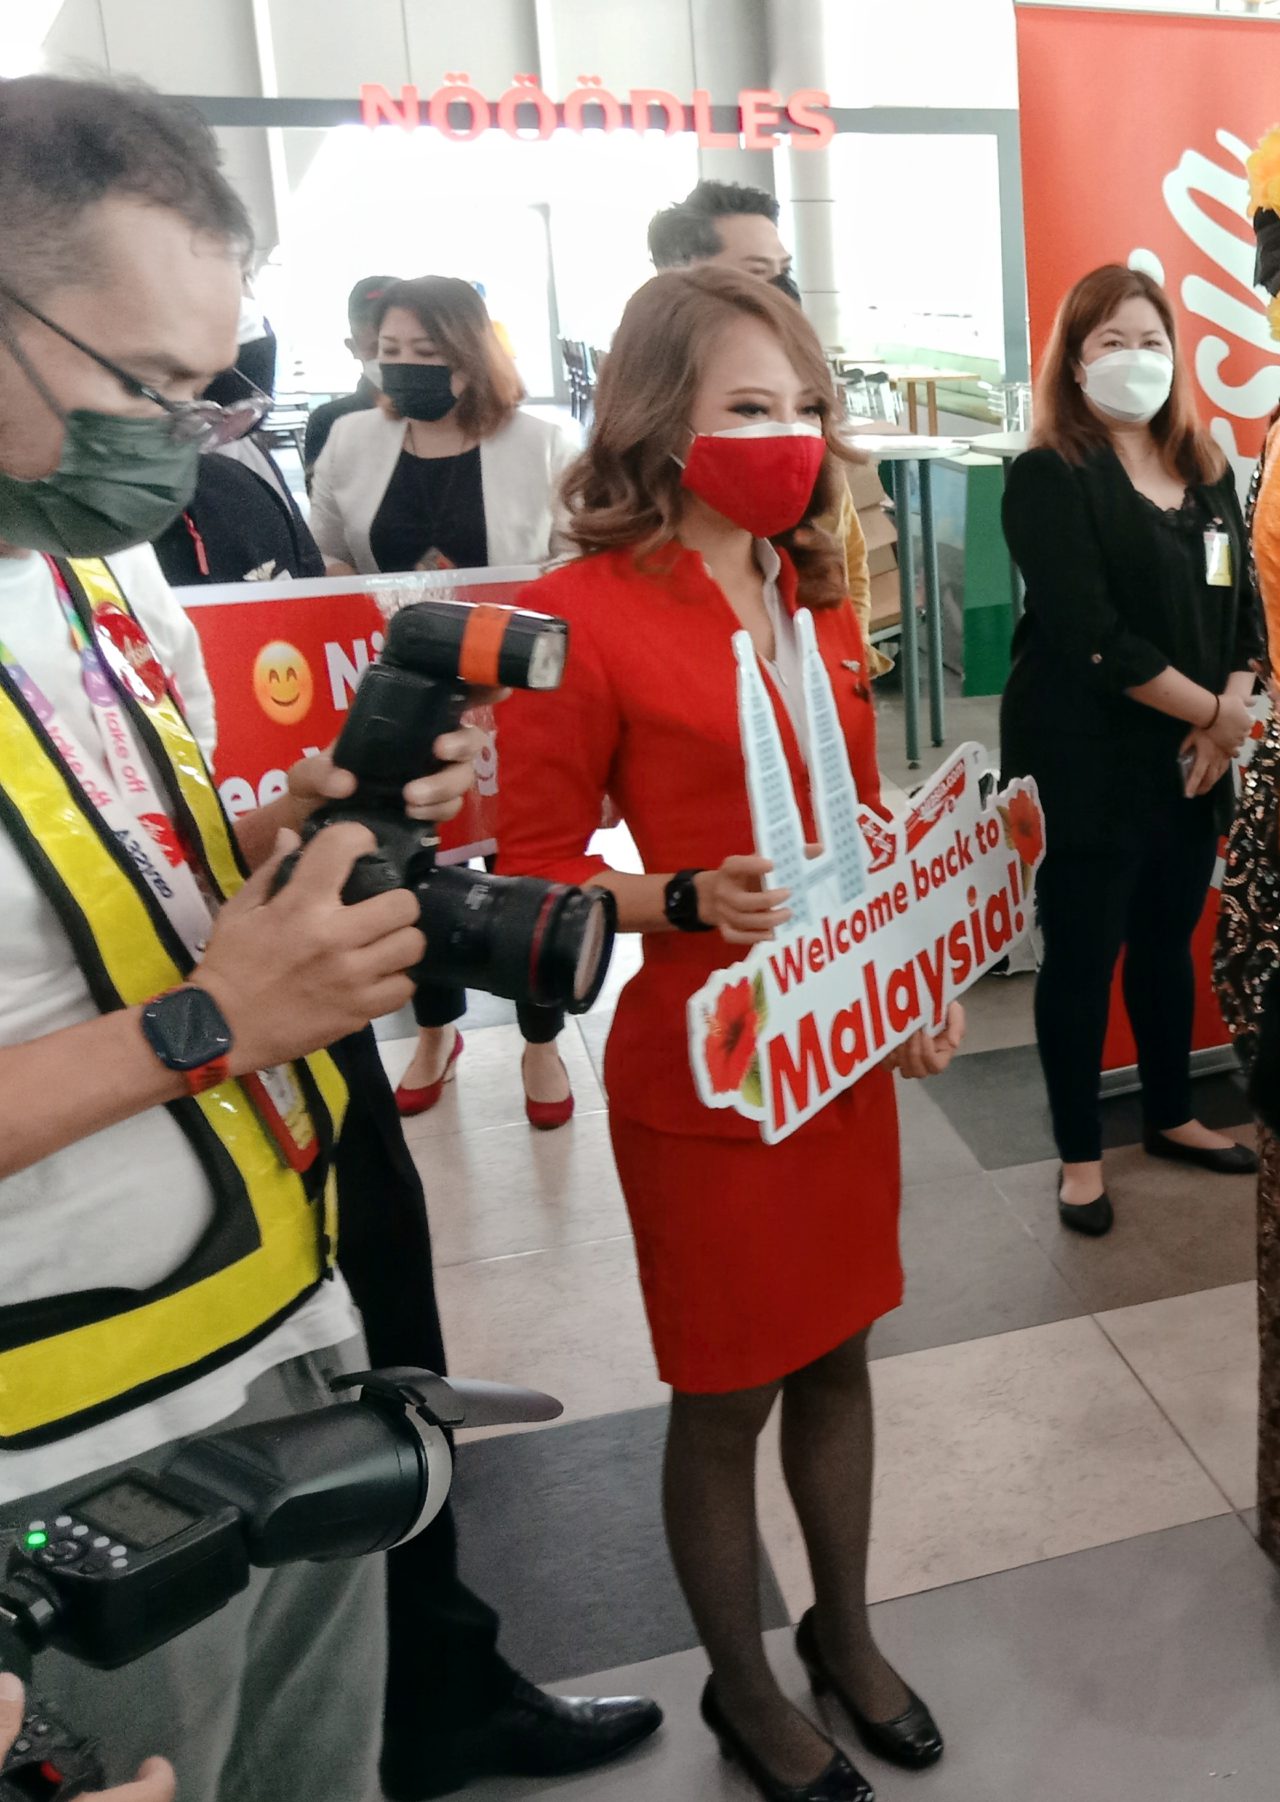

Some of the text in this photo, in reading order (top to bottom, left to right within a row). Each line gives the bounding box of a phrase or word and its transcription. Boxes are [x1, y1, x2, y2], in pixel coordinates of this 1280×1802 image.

[360, 74, 838, 150] NÖÖÖDLES
[104, 711, 148, 793] take off
[768, 880, 908, 996] Welcome
[910, 828, 973, 902] back
[974, 815, 1000, 856] to
[767, 860, 1026, 1132] Malaysia!
